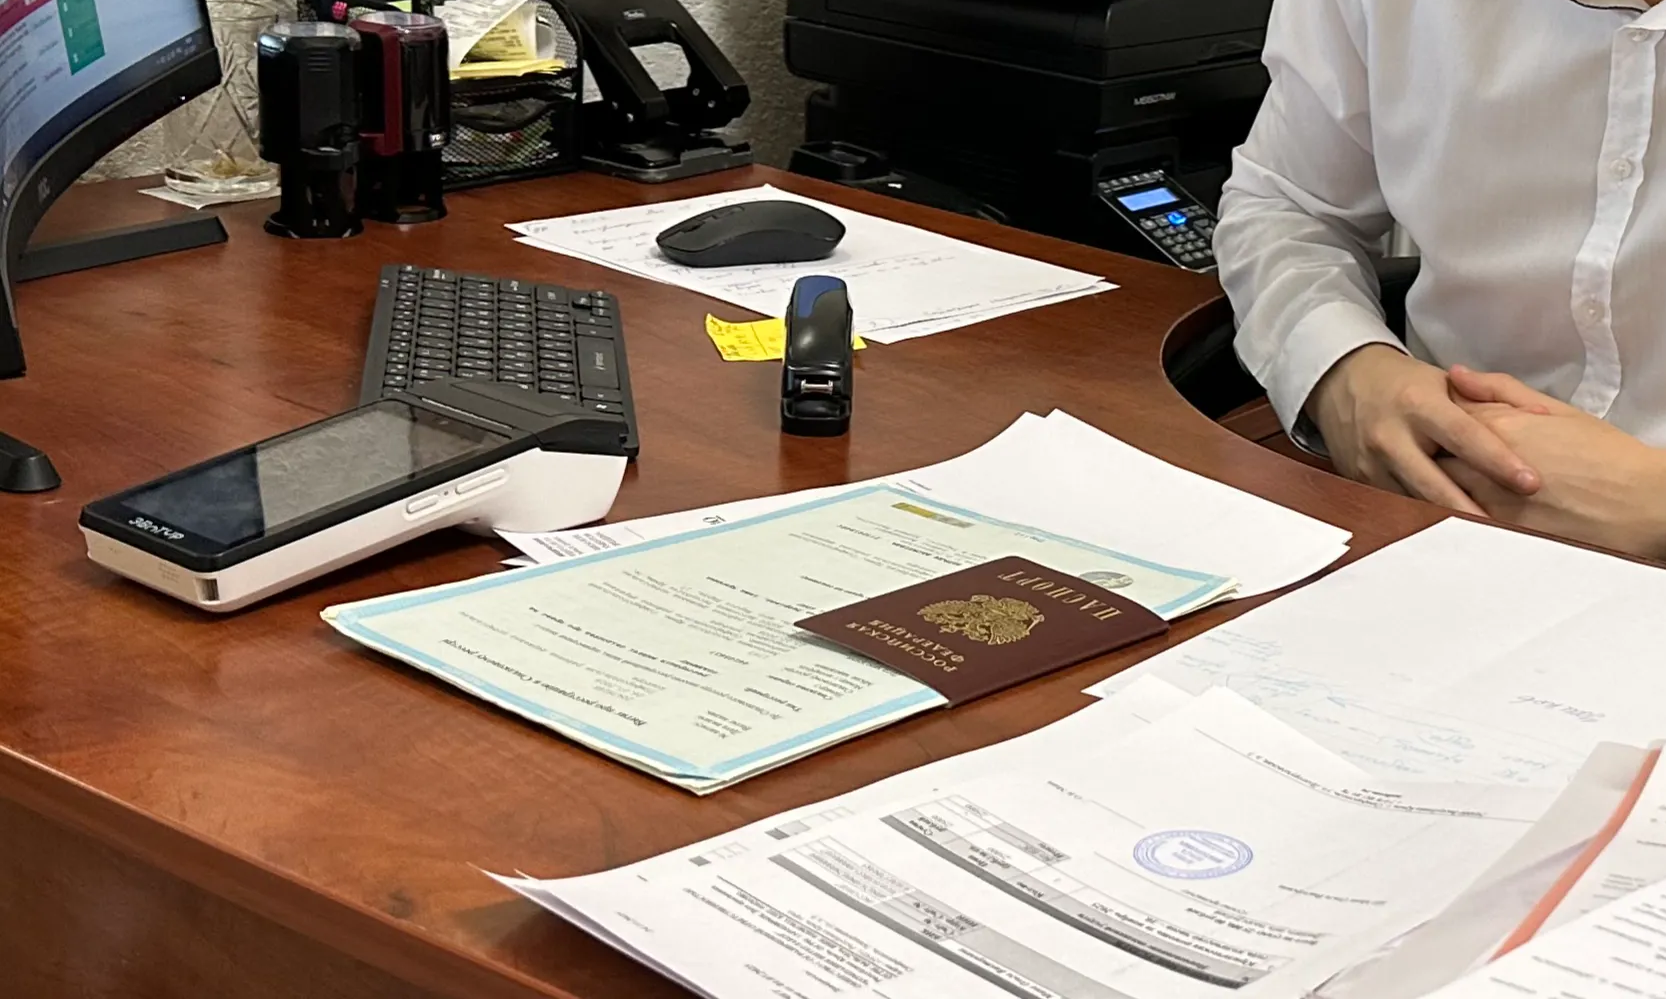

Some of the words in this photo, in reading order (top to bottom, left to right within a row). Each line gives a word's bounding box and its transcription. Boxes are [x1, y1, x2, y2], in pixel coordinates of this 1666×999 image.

[996, 567, 1123, 622] ПАСПОРТ
[844, 620, 959, 674] РОССИЙСКАЯ
[867, 618, 965, 664] ФЕДЕРАЦИЯ
